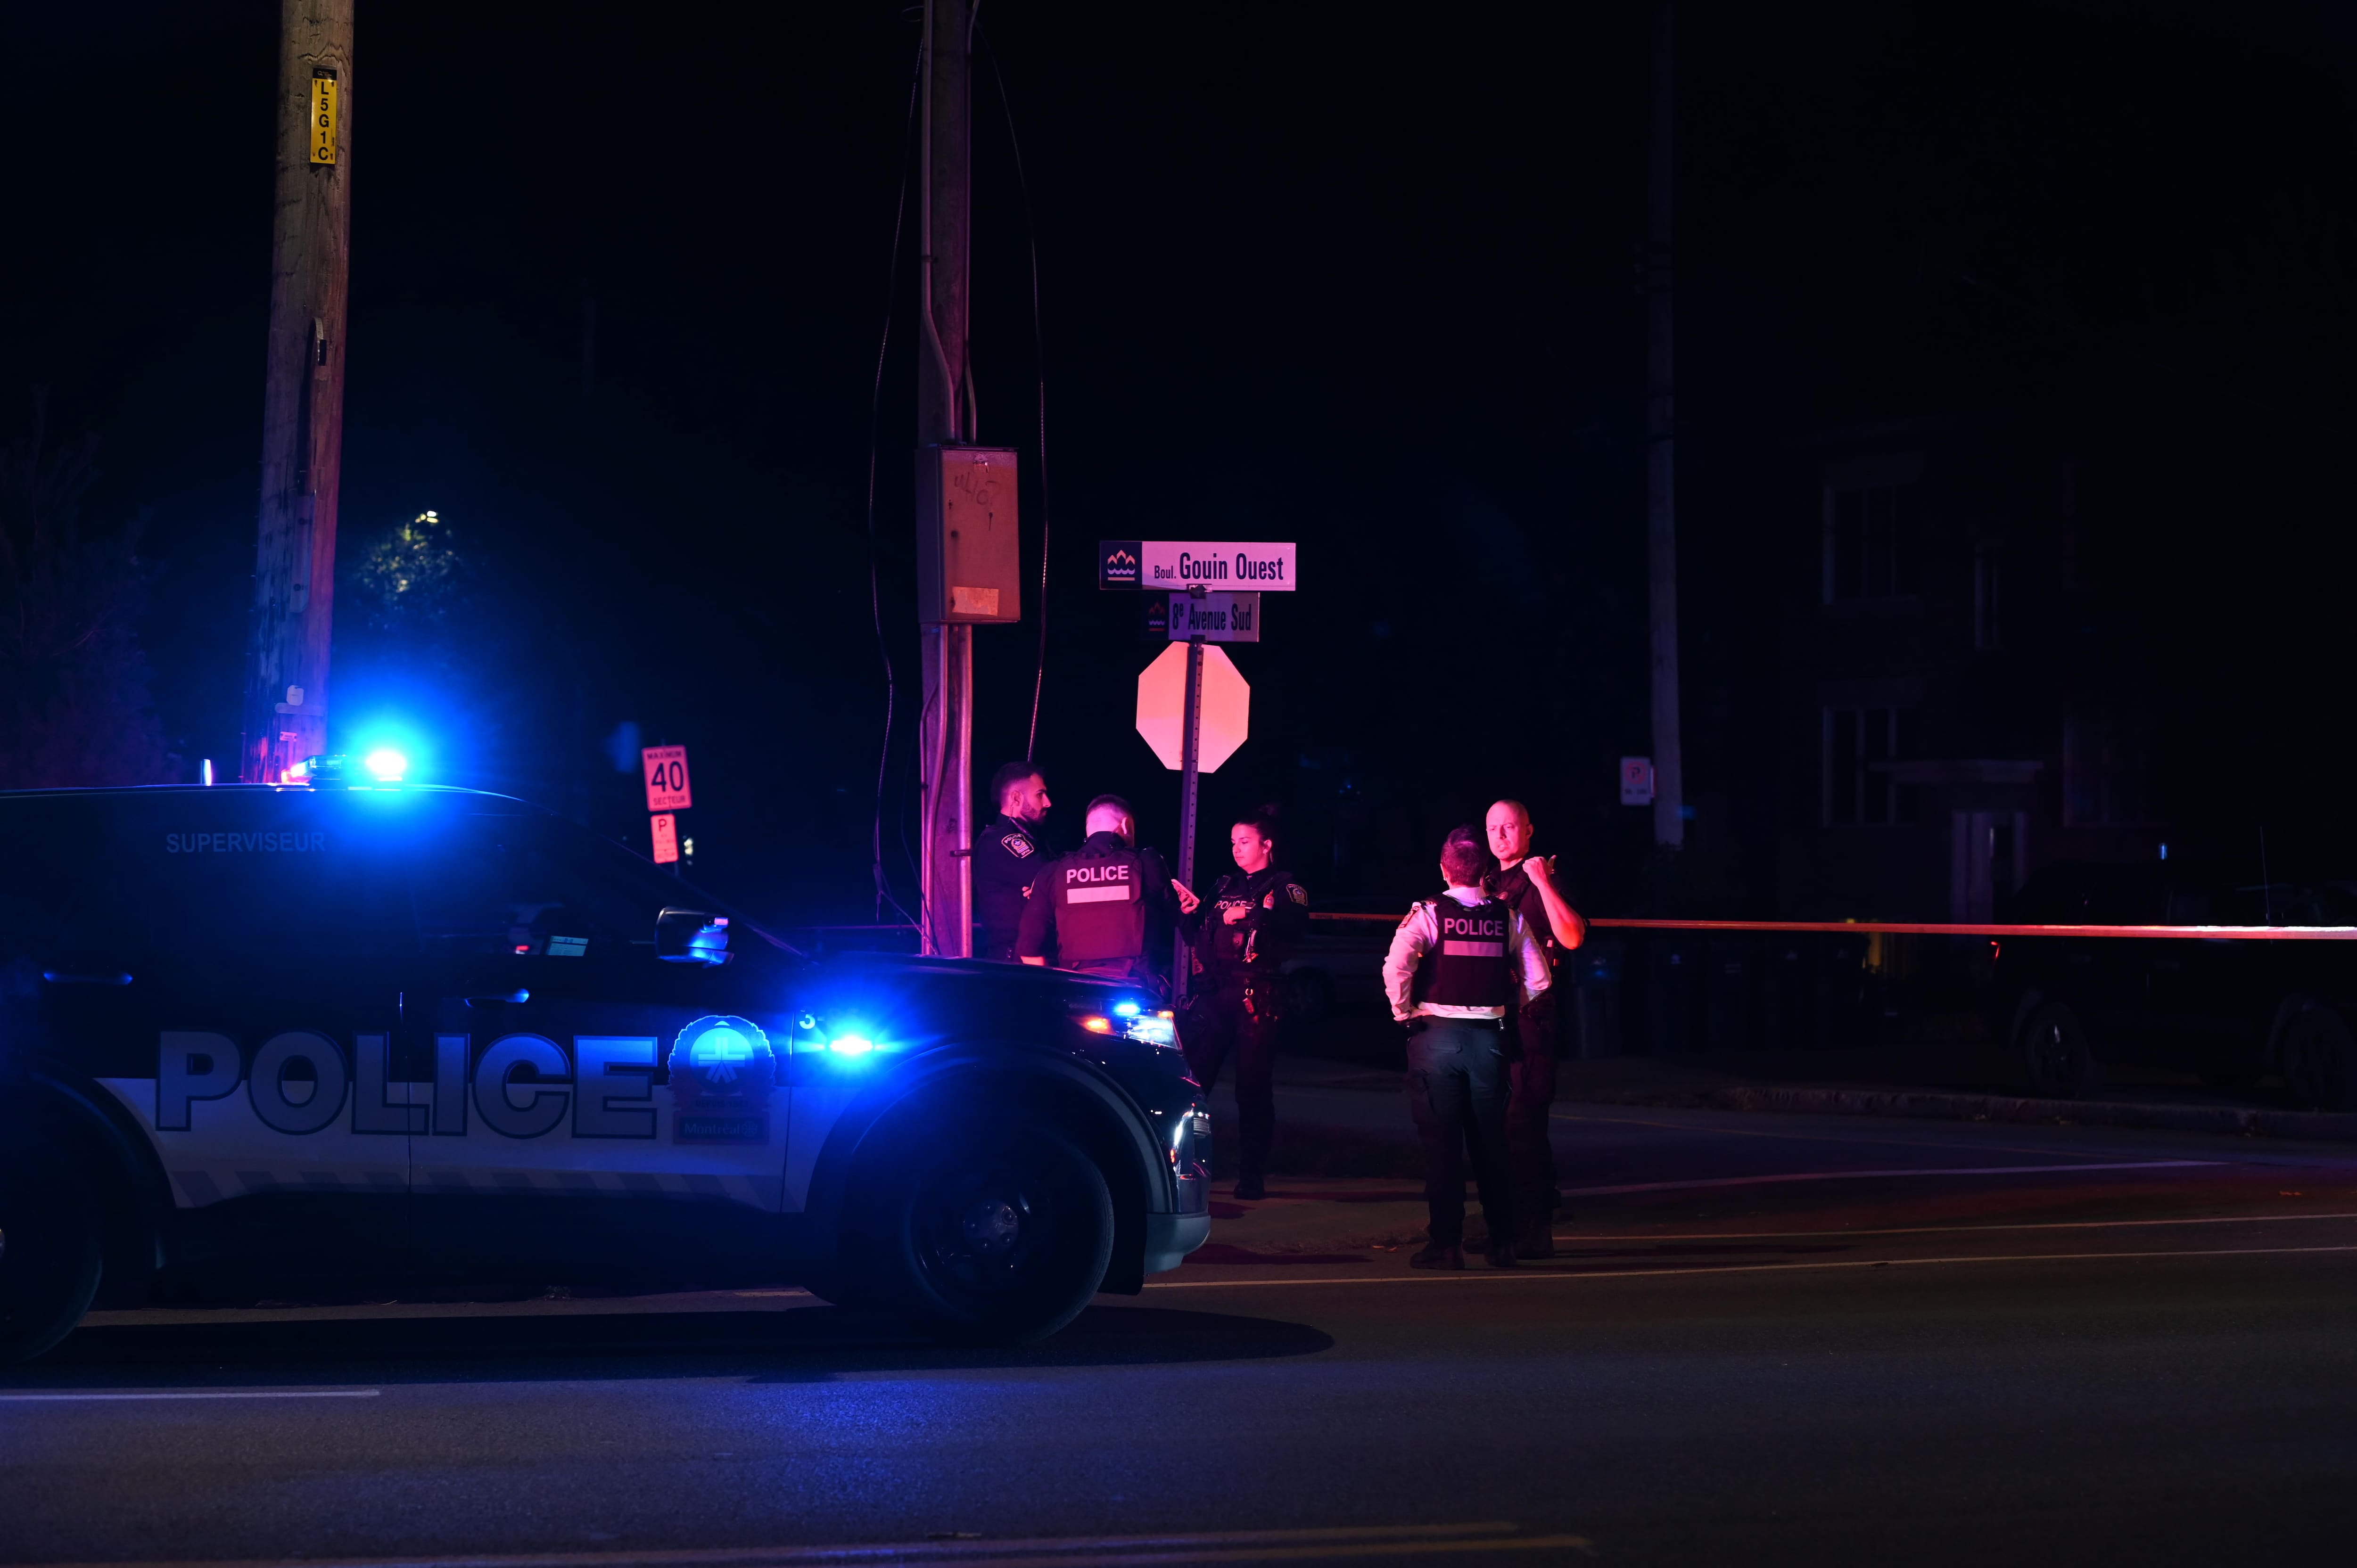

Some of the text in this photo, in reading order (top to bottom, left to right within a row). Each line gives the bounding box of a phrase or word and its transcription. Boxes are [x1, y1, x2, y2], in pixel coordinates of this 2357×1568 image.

[318, 82, 329, 160] L5G1C
[1154, 552, 1284, 580] Boul. Gouin Ouest
[1188, 604, 1226, 631] Avenue
[1231, 604, 1252, 631] Sud
[651, 761, 684, 792] 40
[659, 819, 667, 832] P
[166, 832, 326, 853] SUPERVISEUR
[1066, 865, 1129, 883] POLICE
[1444, 918, 1504, 936] POLICE
[156, 1031, 658, 1139] POLICE
[684, 1122, 740, 1135] Montréal
